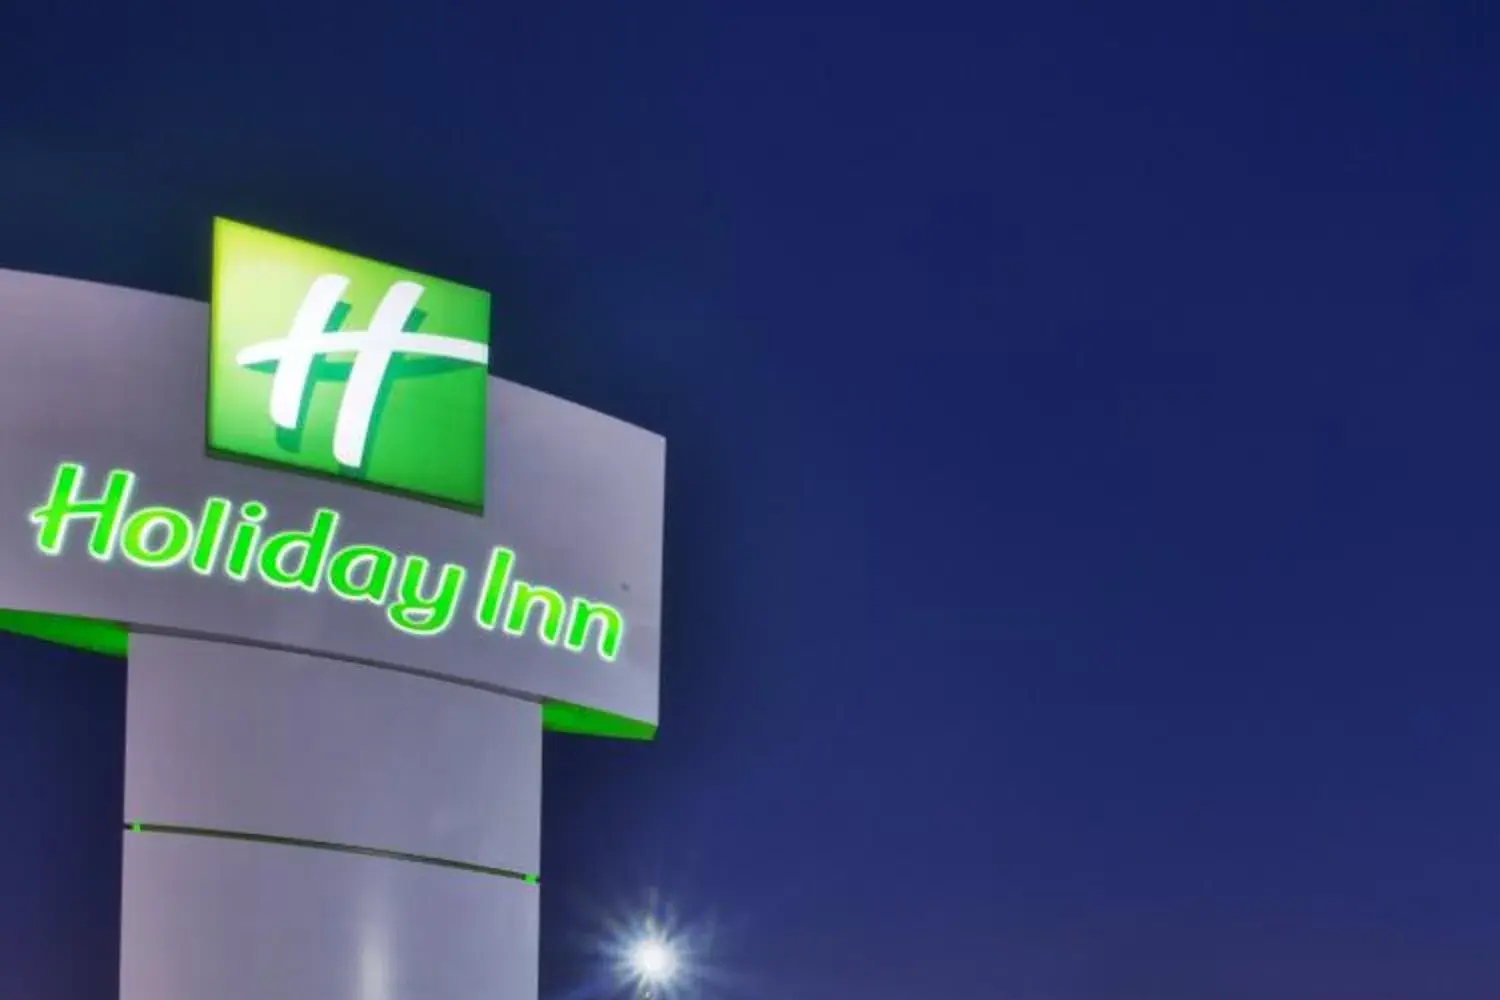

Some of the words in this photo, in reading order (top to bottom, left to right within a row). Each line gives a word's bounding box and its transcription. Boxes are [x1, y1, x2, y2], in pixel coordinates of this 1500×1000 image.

[235, 273, 489, 468] H
[30, 462, 466, 636] Holiday
[475, 546, 624, 662] Inn
